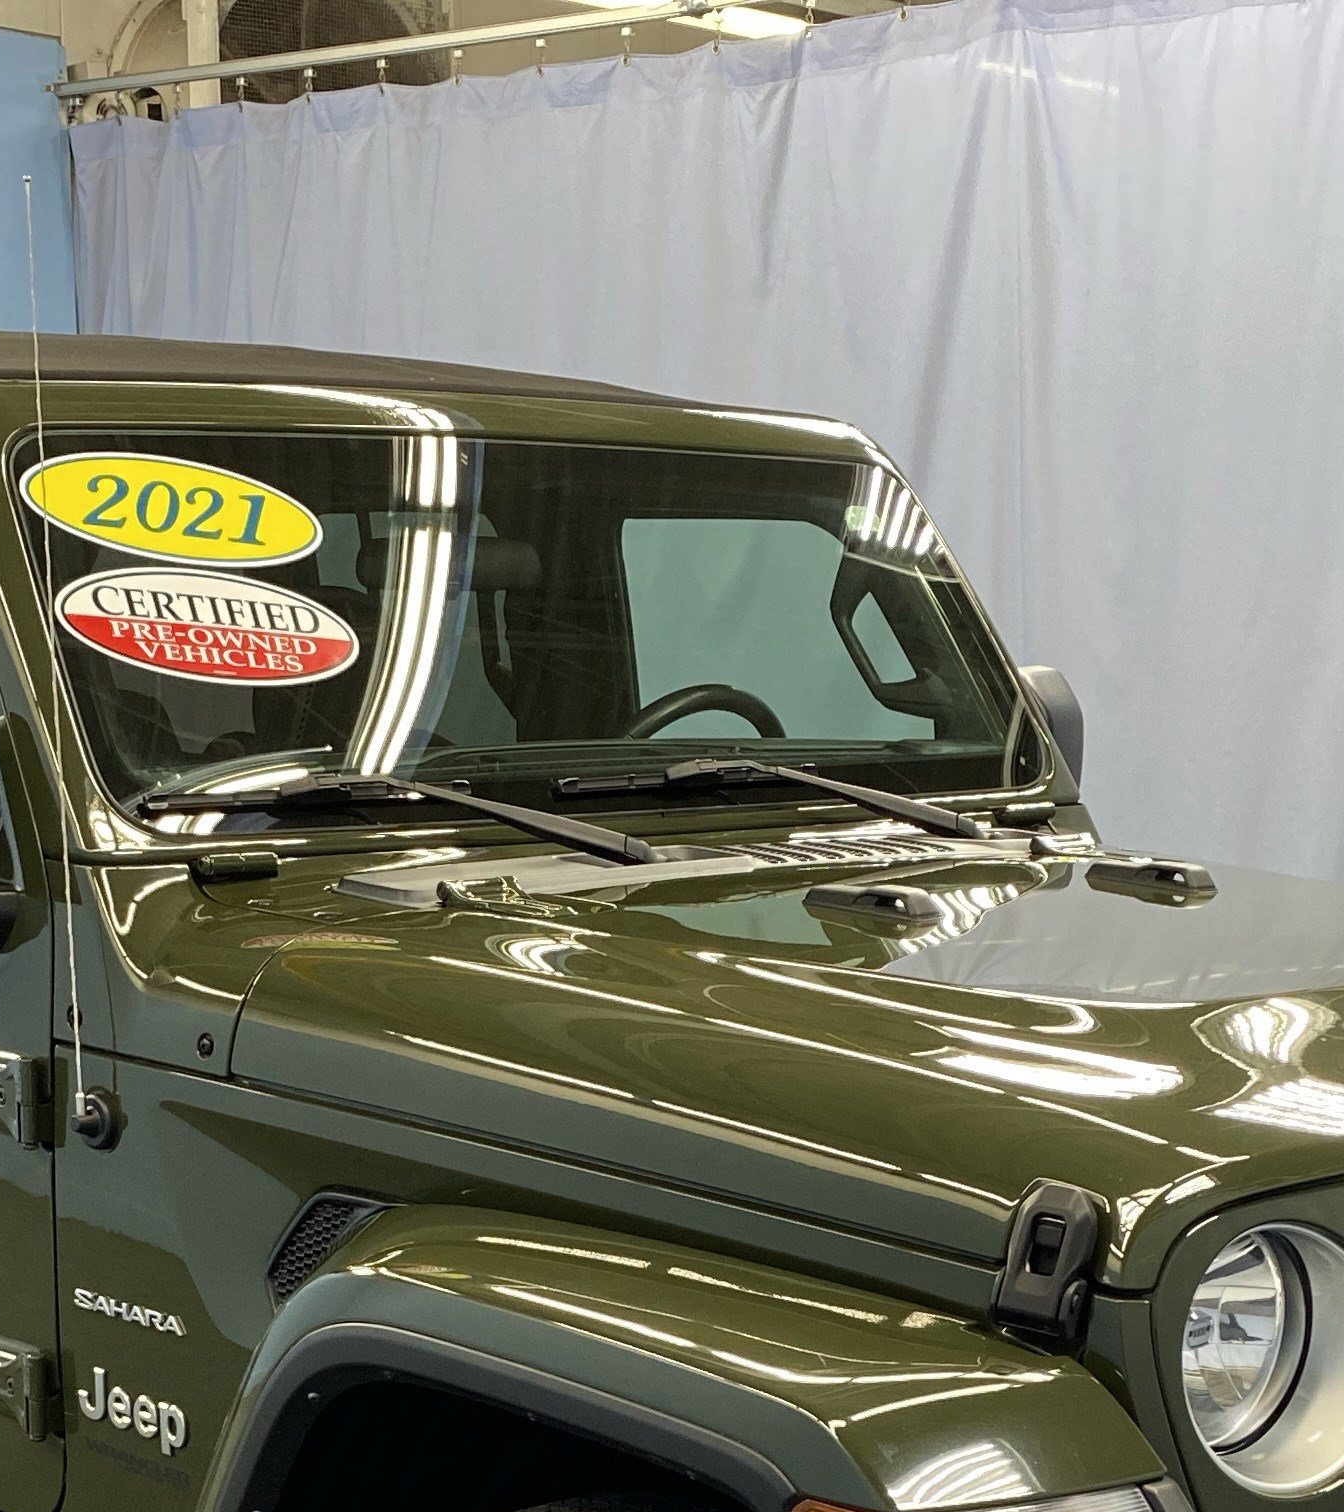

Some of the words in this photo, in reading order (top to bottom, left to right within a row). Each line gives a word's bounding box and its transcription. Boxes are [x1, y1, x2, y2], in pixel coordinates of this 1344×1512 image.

[83, 474, 266, 546] 2021
[91, 585, 320, 635] CERTIFIED
[110, 620, 317, 656] PRE-OWNED
[134, 639, 304, 673] VEHICLES
[73, 1287, 186, 1337] SAHARA
[77, 1366, 187, 1457] Jeep
